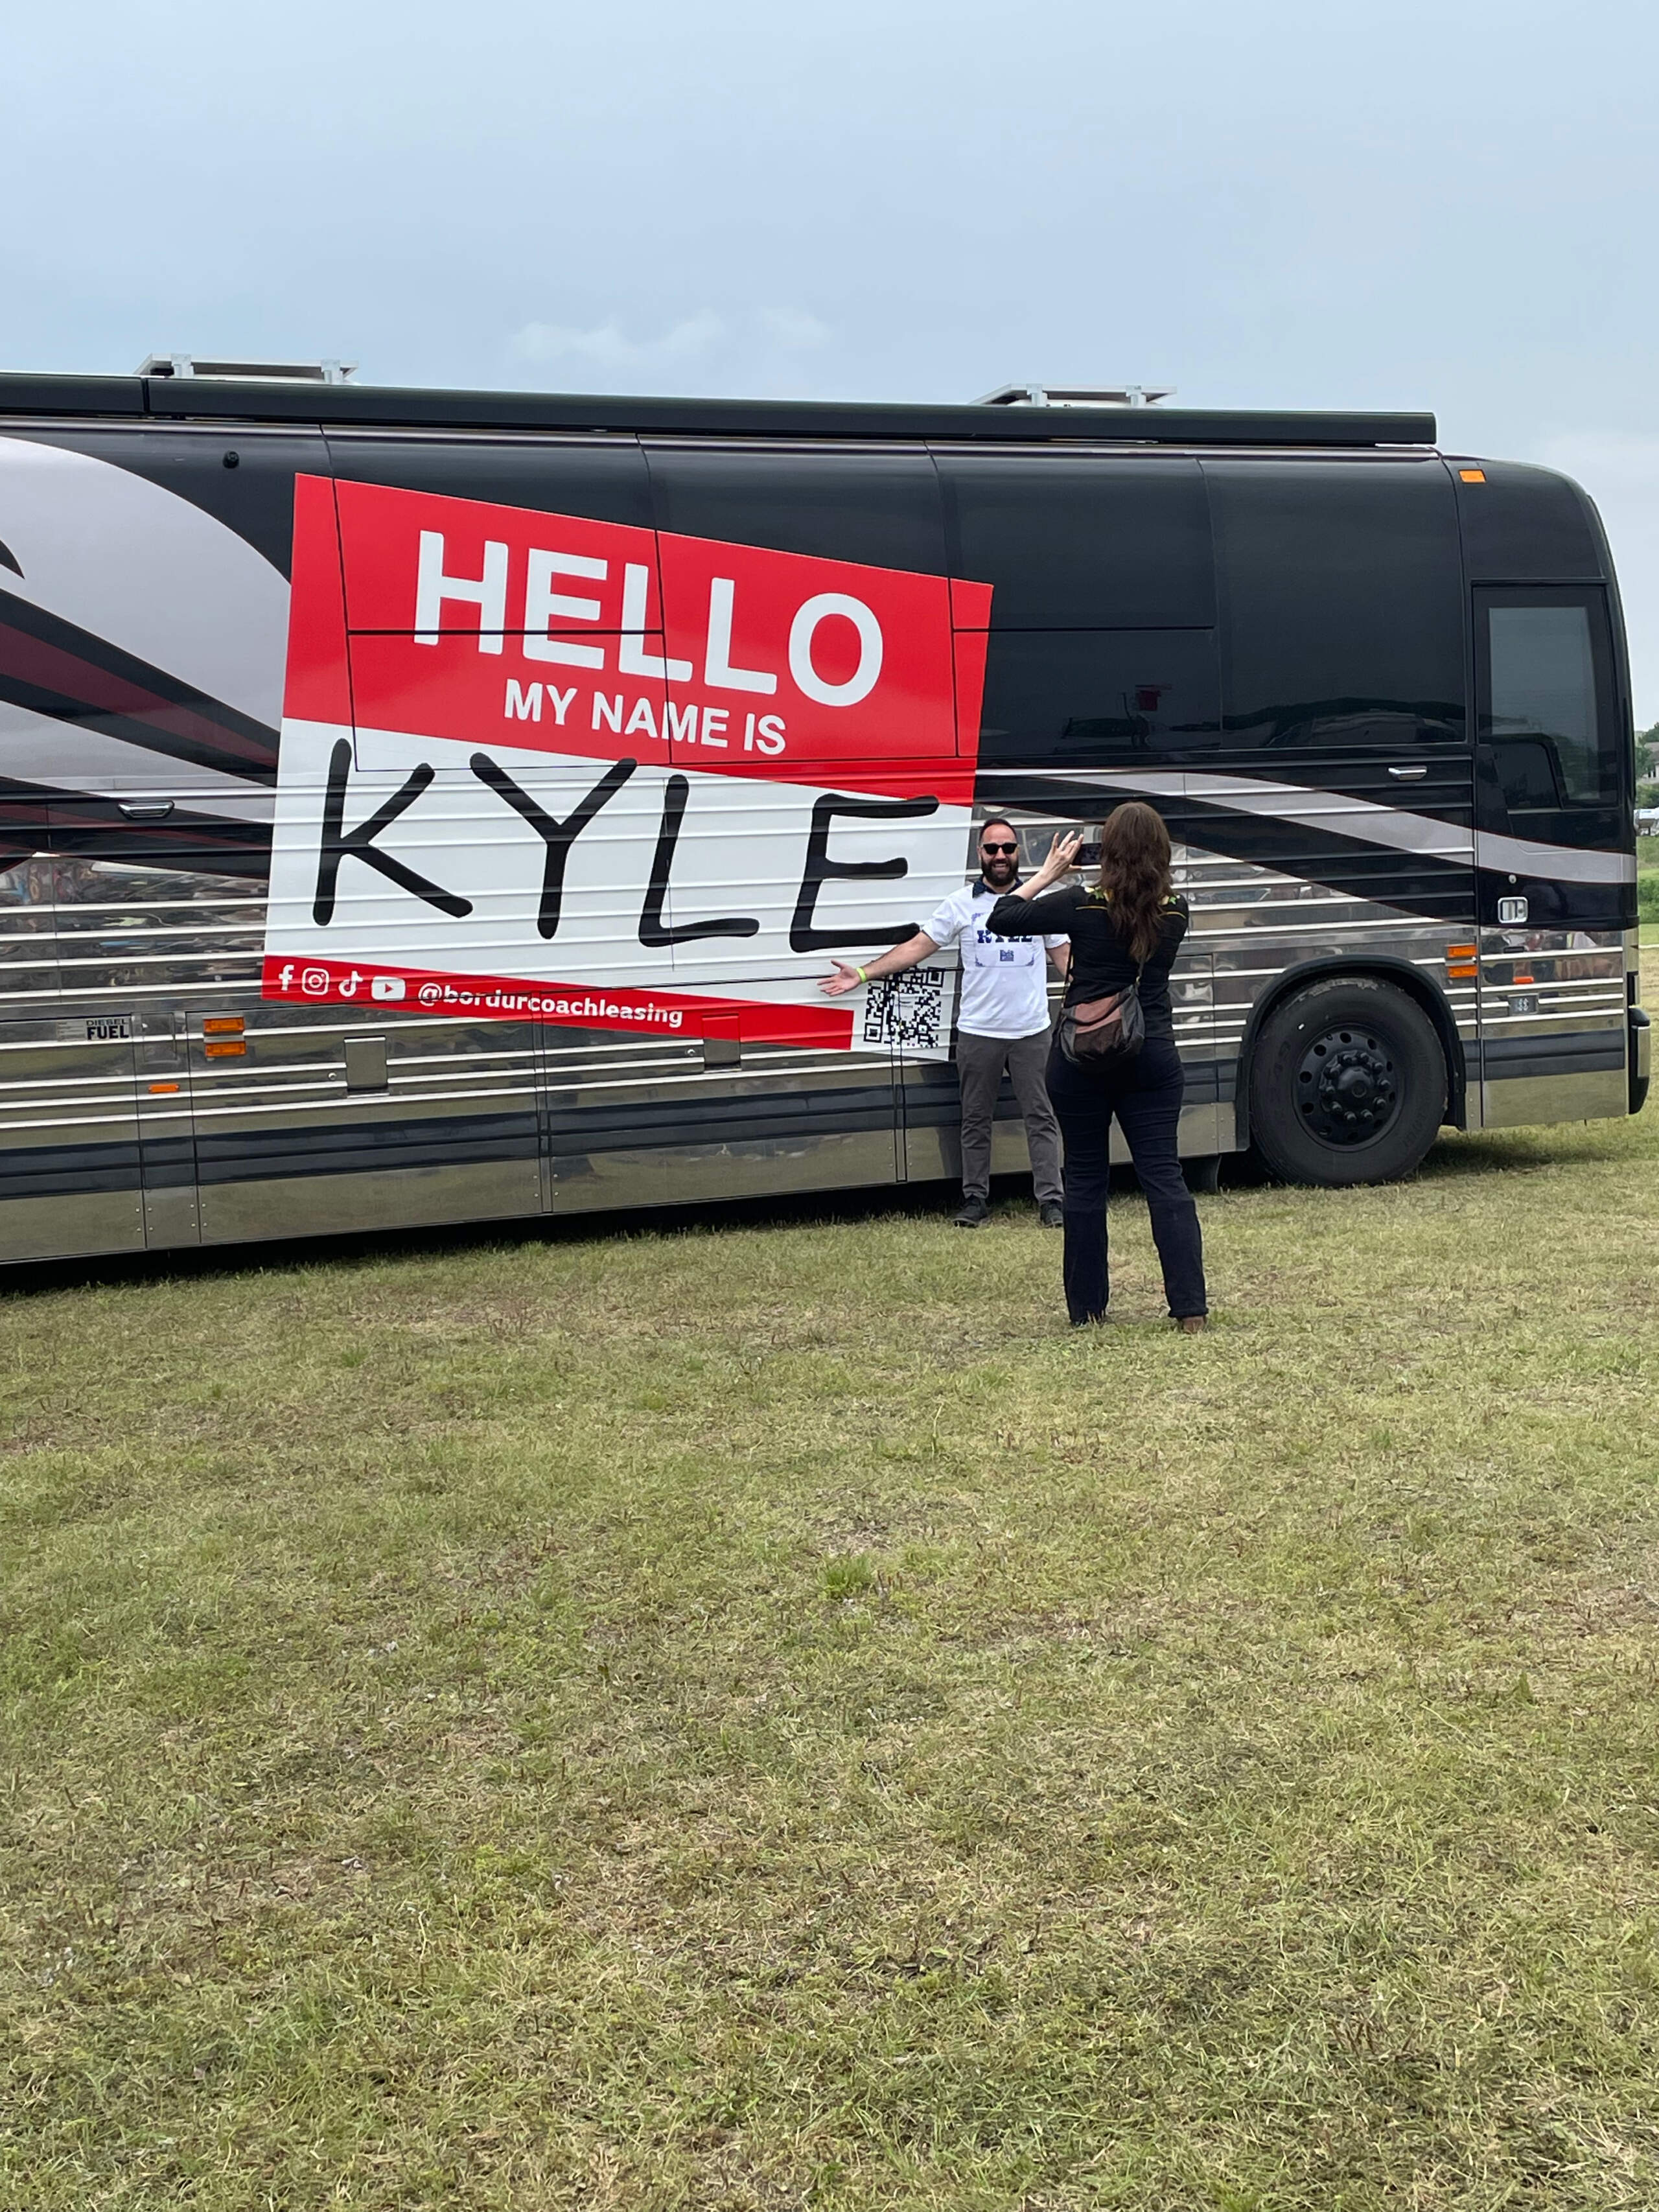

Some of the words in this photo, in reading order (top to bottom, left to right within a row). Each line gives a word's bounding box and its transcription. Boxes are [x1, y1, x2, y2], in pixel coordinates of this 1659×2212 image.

[413, 530, 883, 706] HELLO
[504, 679, 578, 726] MY
[591, 692, 729, 748] NAME
[743, 713, 786, 755] IS
[312, 738, 940, 953] KYLE
[87, 1025, 130, 1040] FUEL
[418, 982, 683, 1028] @bordurcoachleasing
